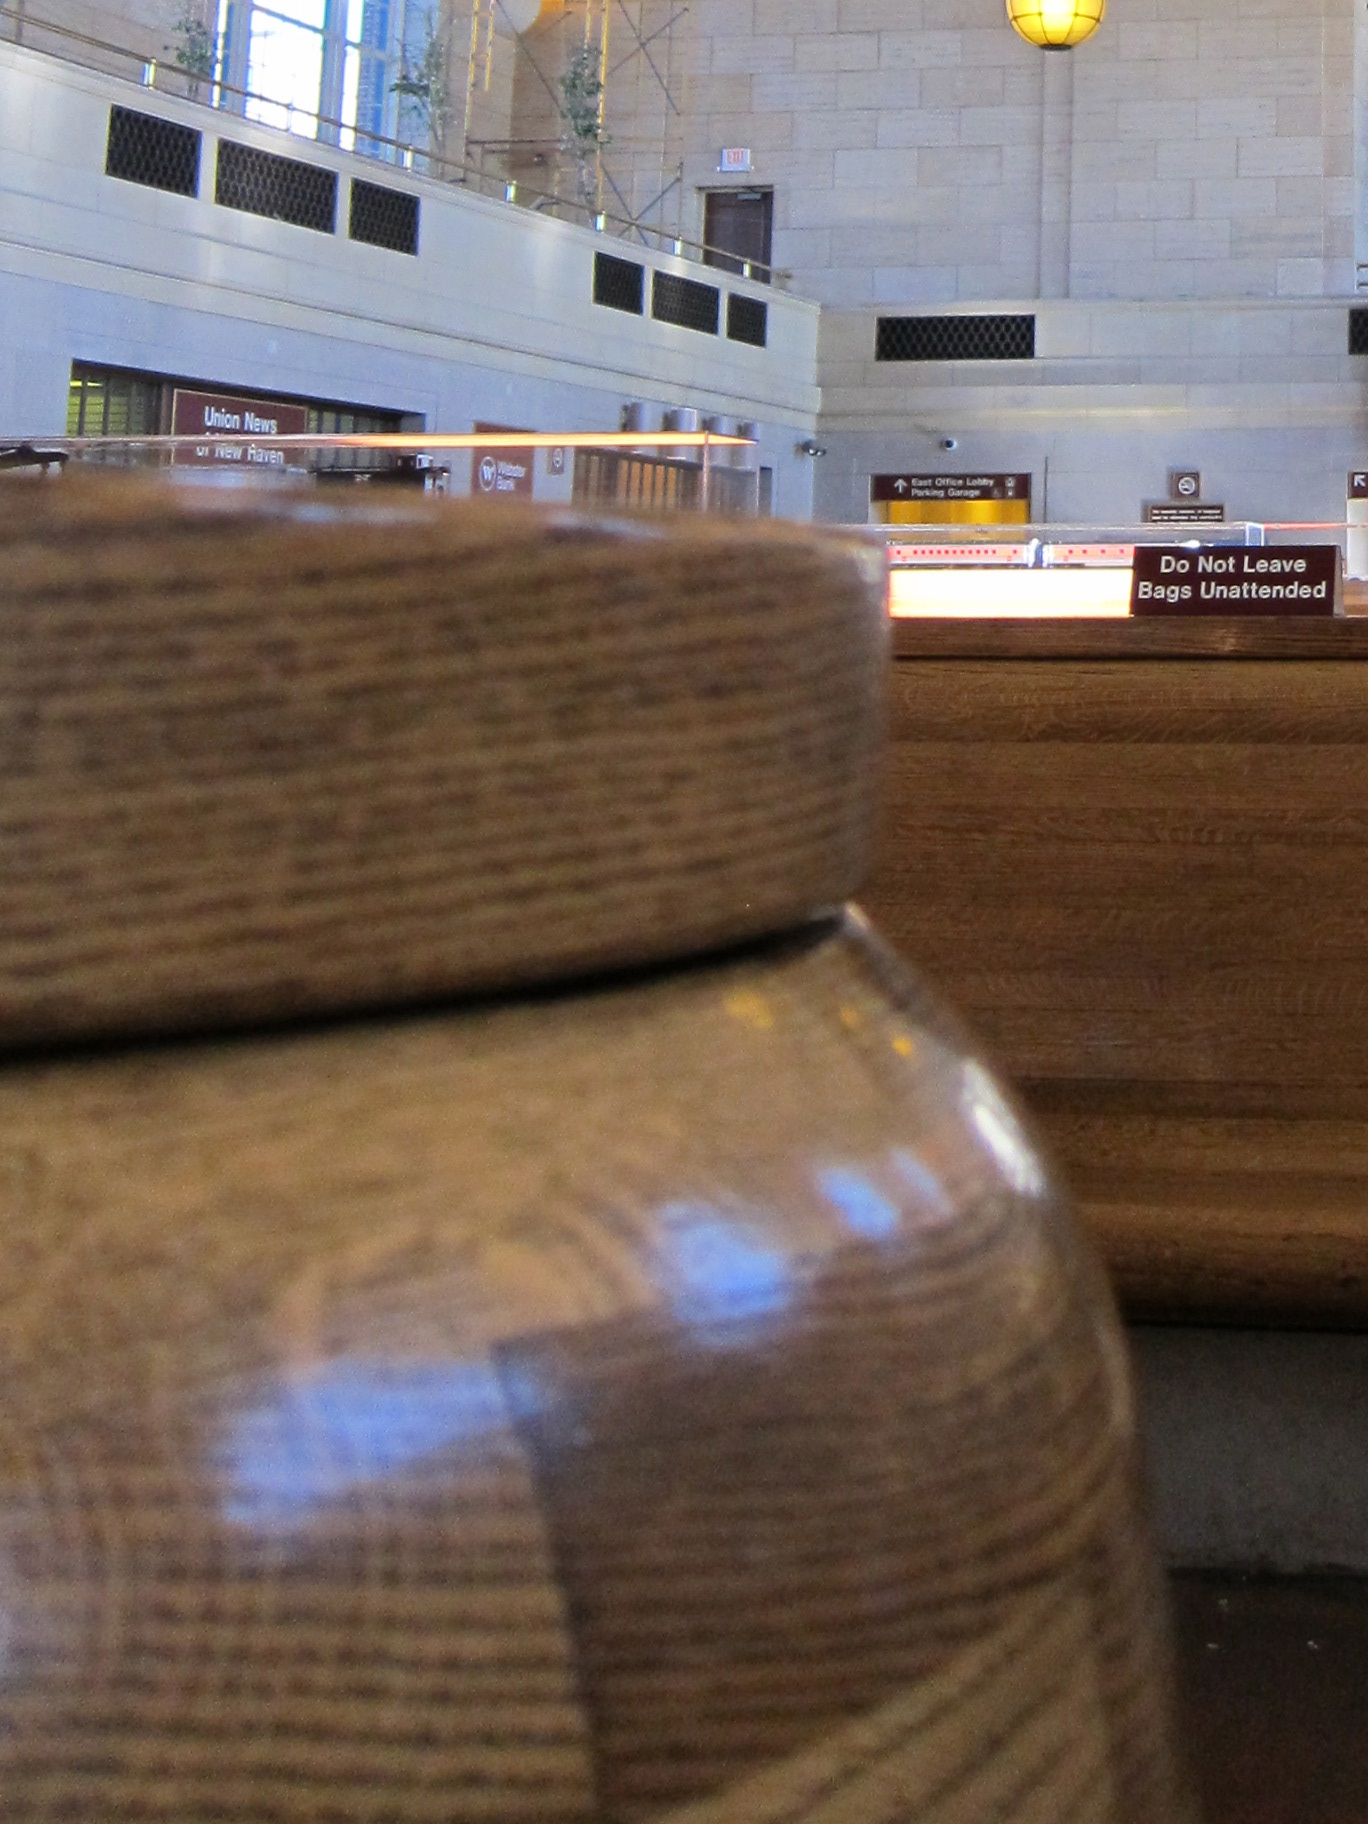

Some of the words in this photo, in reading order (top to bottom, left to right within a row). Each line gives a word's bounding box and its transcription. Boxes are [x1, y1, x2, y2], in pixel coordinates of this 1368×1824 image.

[727, 150, 745, 164] EXIT
[204, 405, 240, 429] Union
[244, 411, 278, 434] News
[214, 443, 243, 460] New
[247, 444, 284, 464] Haven
[911, 478, 933, 487] East
[935, 477, 963, 487] Office
[966, 477, 995, 488] Lobby
[911, 488, 945, 499] Parking
[947, 488, 981, 499] Garage
[1160, 556, 1190, 573] Do
[1197, 556, 1235, 573] Not
[1243, 555, 1307, 573] Leave
[1137, 581, 1192, 603] Bags
[1200, 580, 1327, 599] Unattended
